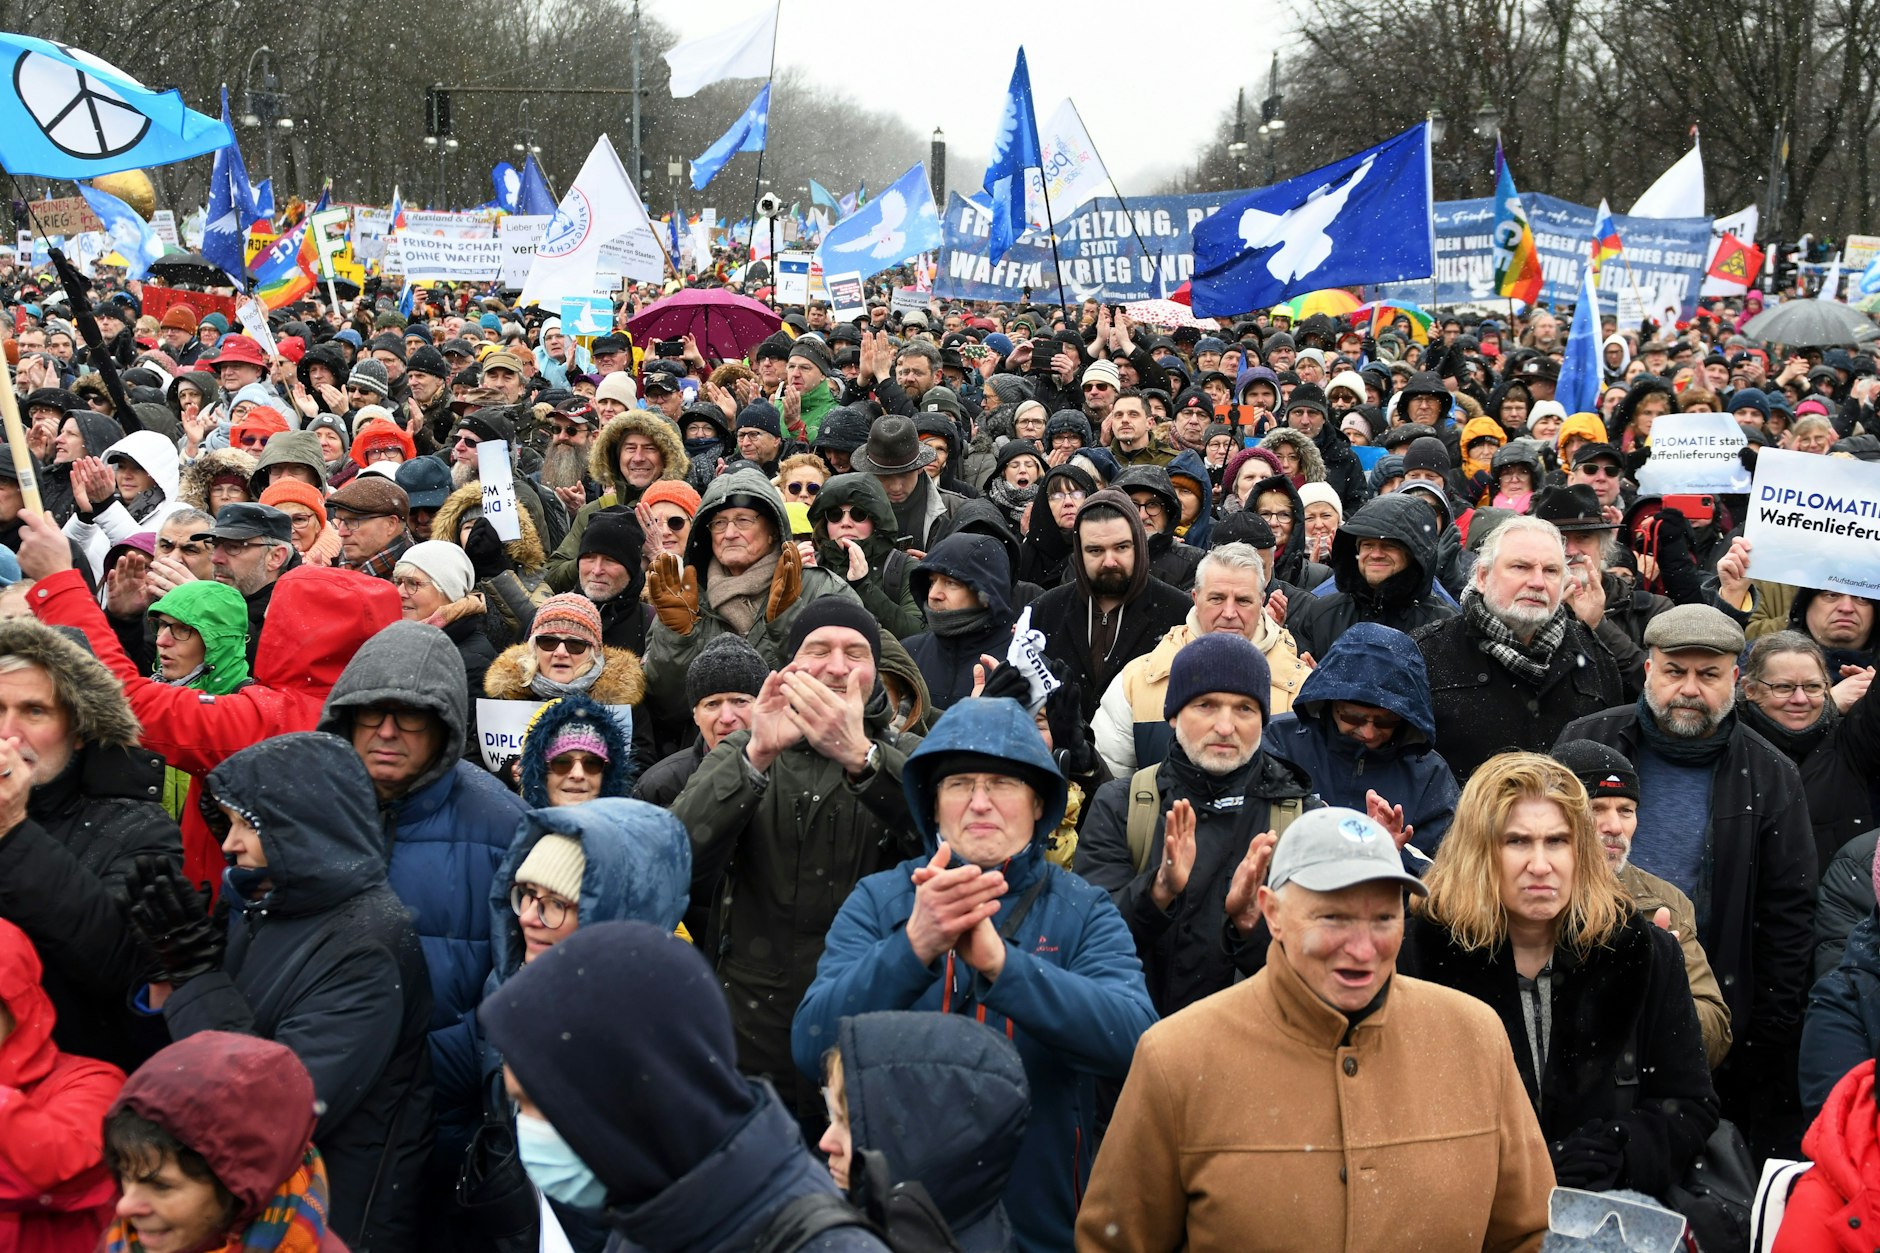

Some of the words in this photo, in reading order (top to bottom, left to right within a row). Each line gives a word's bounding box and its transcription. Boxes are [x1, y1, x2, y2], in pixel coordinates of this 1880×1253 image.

[412, 213, 453, 223] Russland
[506, 223, 532, 232] Lieber
[402, 237, 453, 250] FRIEDEN
[1080, 240, 1118, 257] STATT
[405, 251, 440, 263] OHNE
[444, 252, 501, 265] WAFFEN!
[949, 250, 1051, 289] WAFFEN,
[1058, 256, 1132, 286] KRIEG
[1719, 436, 1746, 447] statt
[1649, 449, 1740, 462] affenlieferunge
